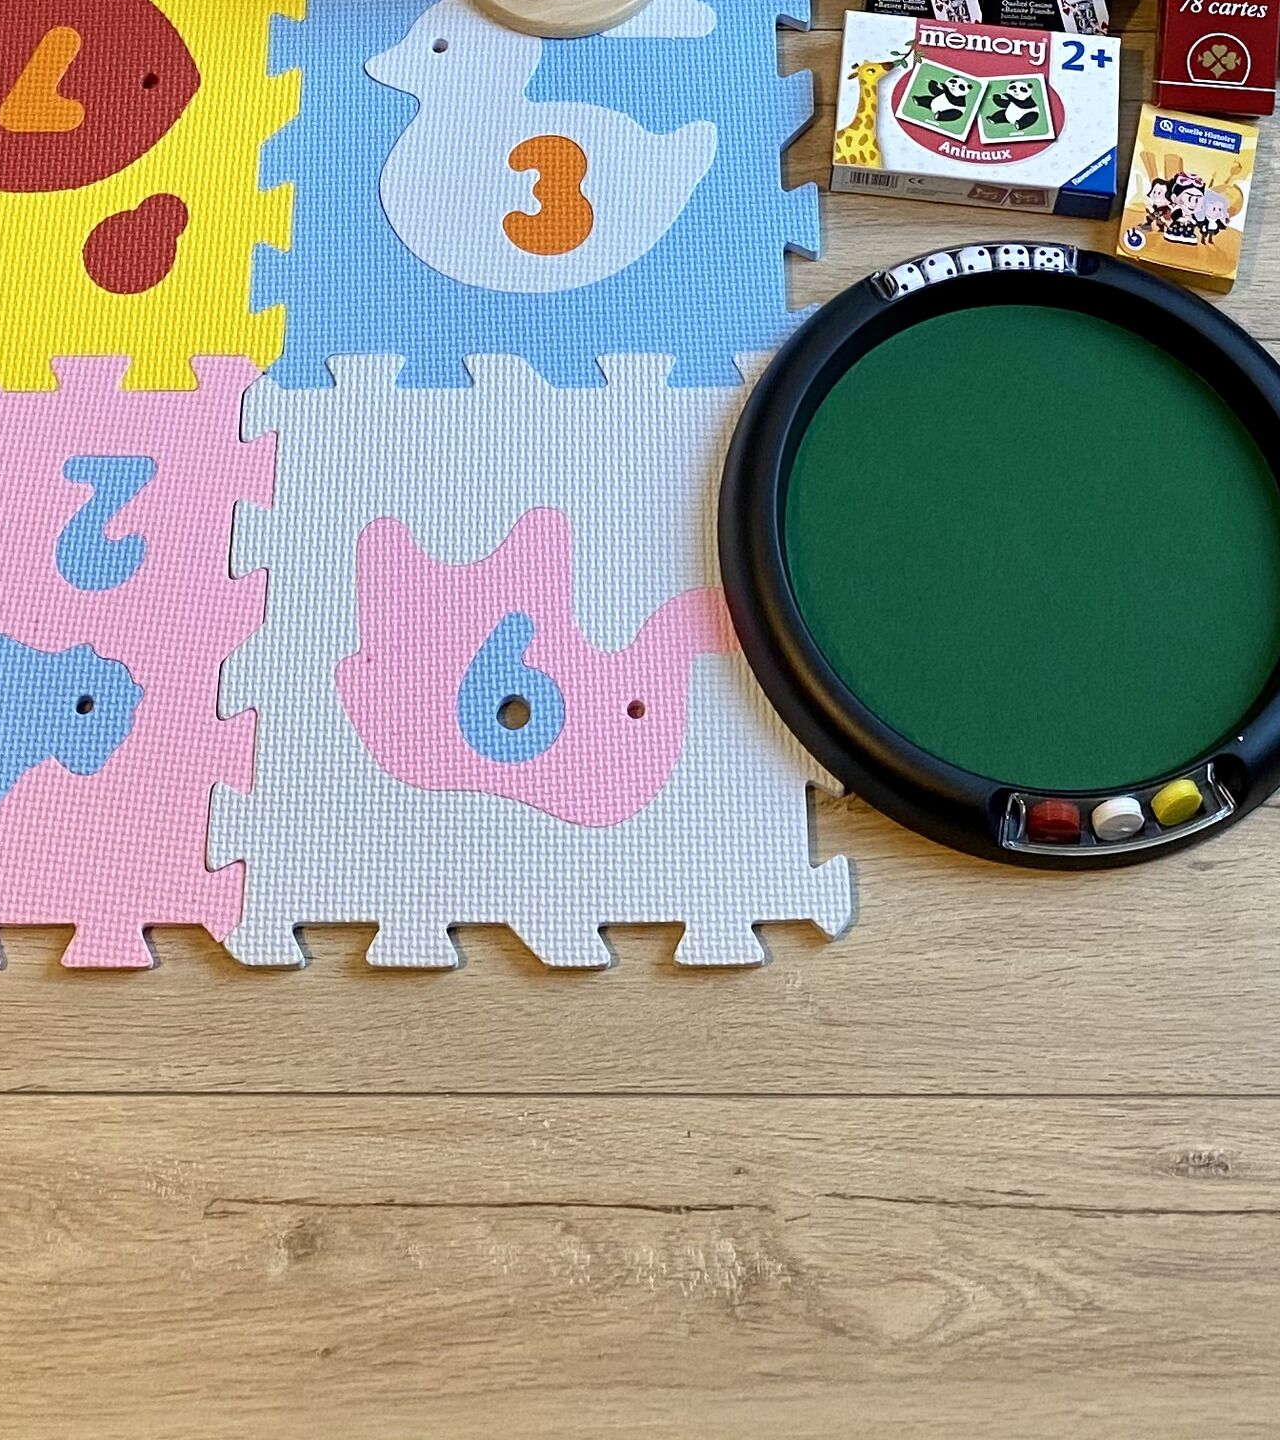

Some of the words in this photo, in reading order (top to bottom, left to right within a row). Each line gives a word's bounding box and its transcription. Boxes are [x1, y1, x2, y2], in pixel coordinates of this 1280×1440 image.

[1208, 0, 1268, 19] cartes
[918, 28, 1047, 66] memory
[1061, 40, 1113, 72] 2+
[938, 140, 1013, 161] Animaux
[1177, 125, 1204, 138] Quelle
[1204, 127, 1237, 144] Histoire
[1070, 153, 1114, 187] Ravensburger
[502, 134, 595, 256] 3
[54, 456, 157, 592] 2
[456, 613, 565, 764] 6
